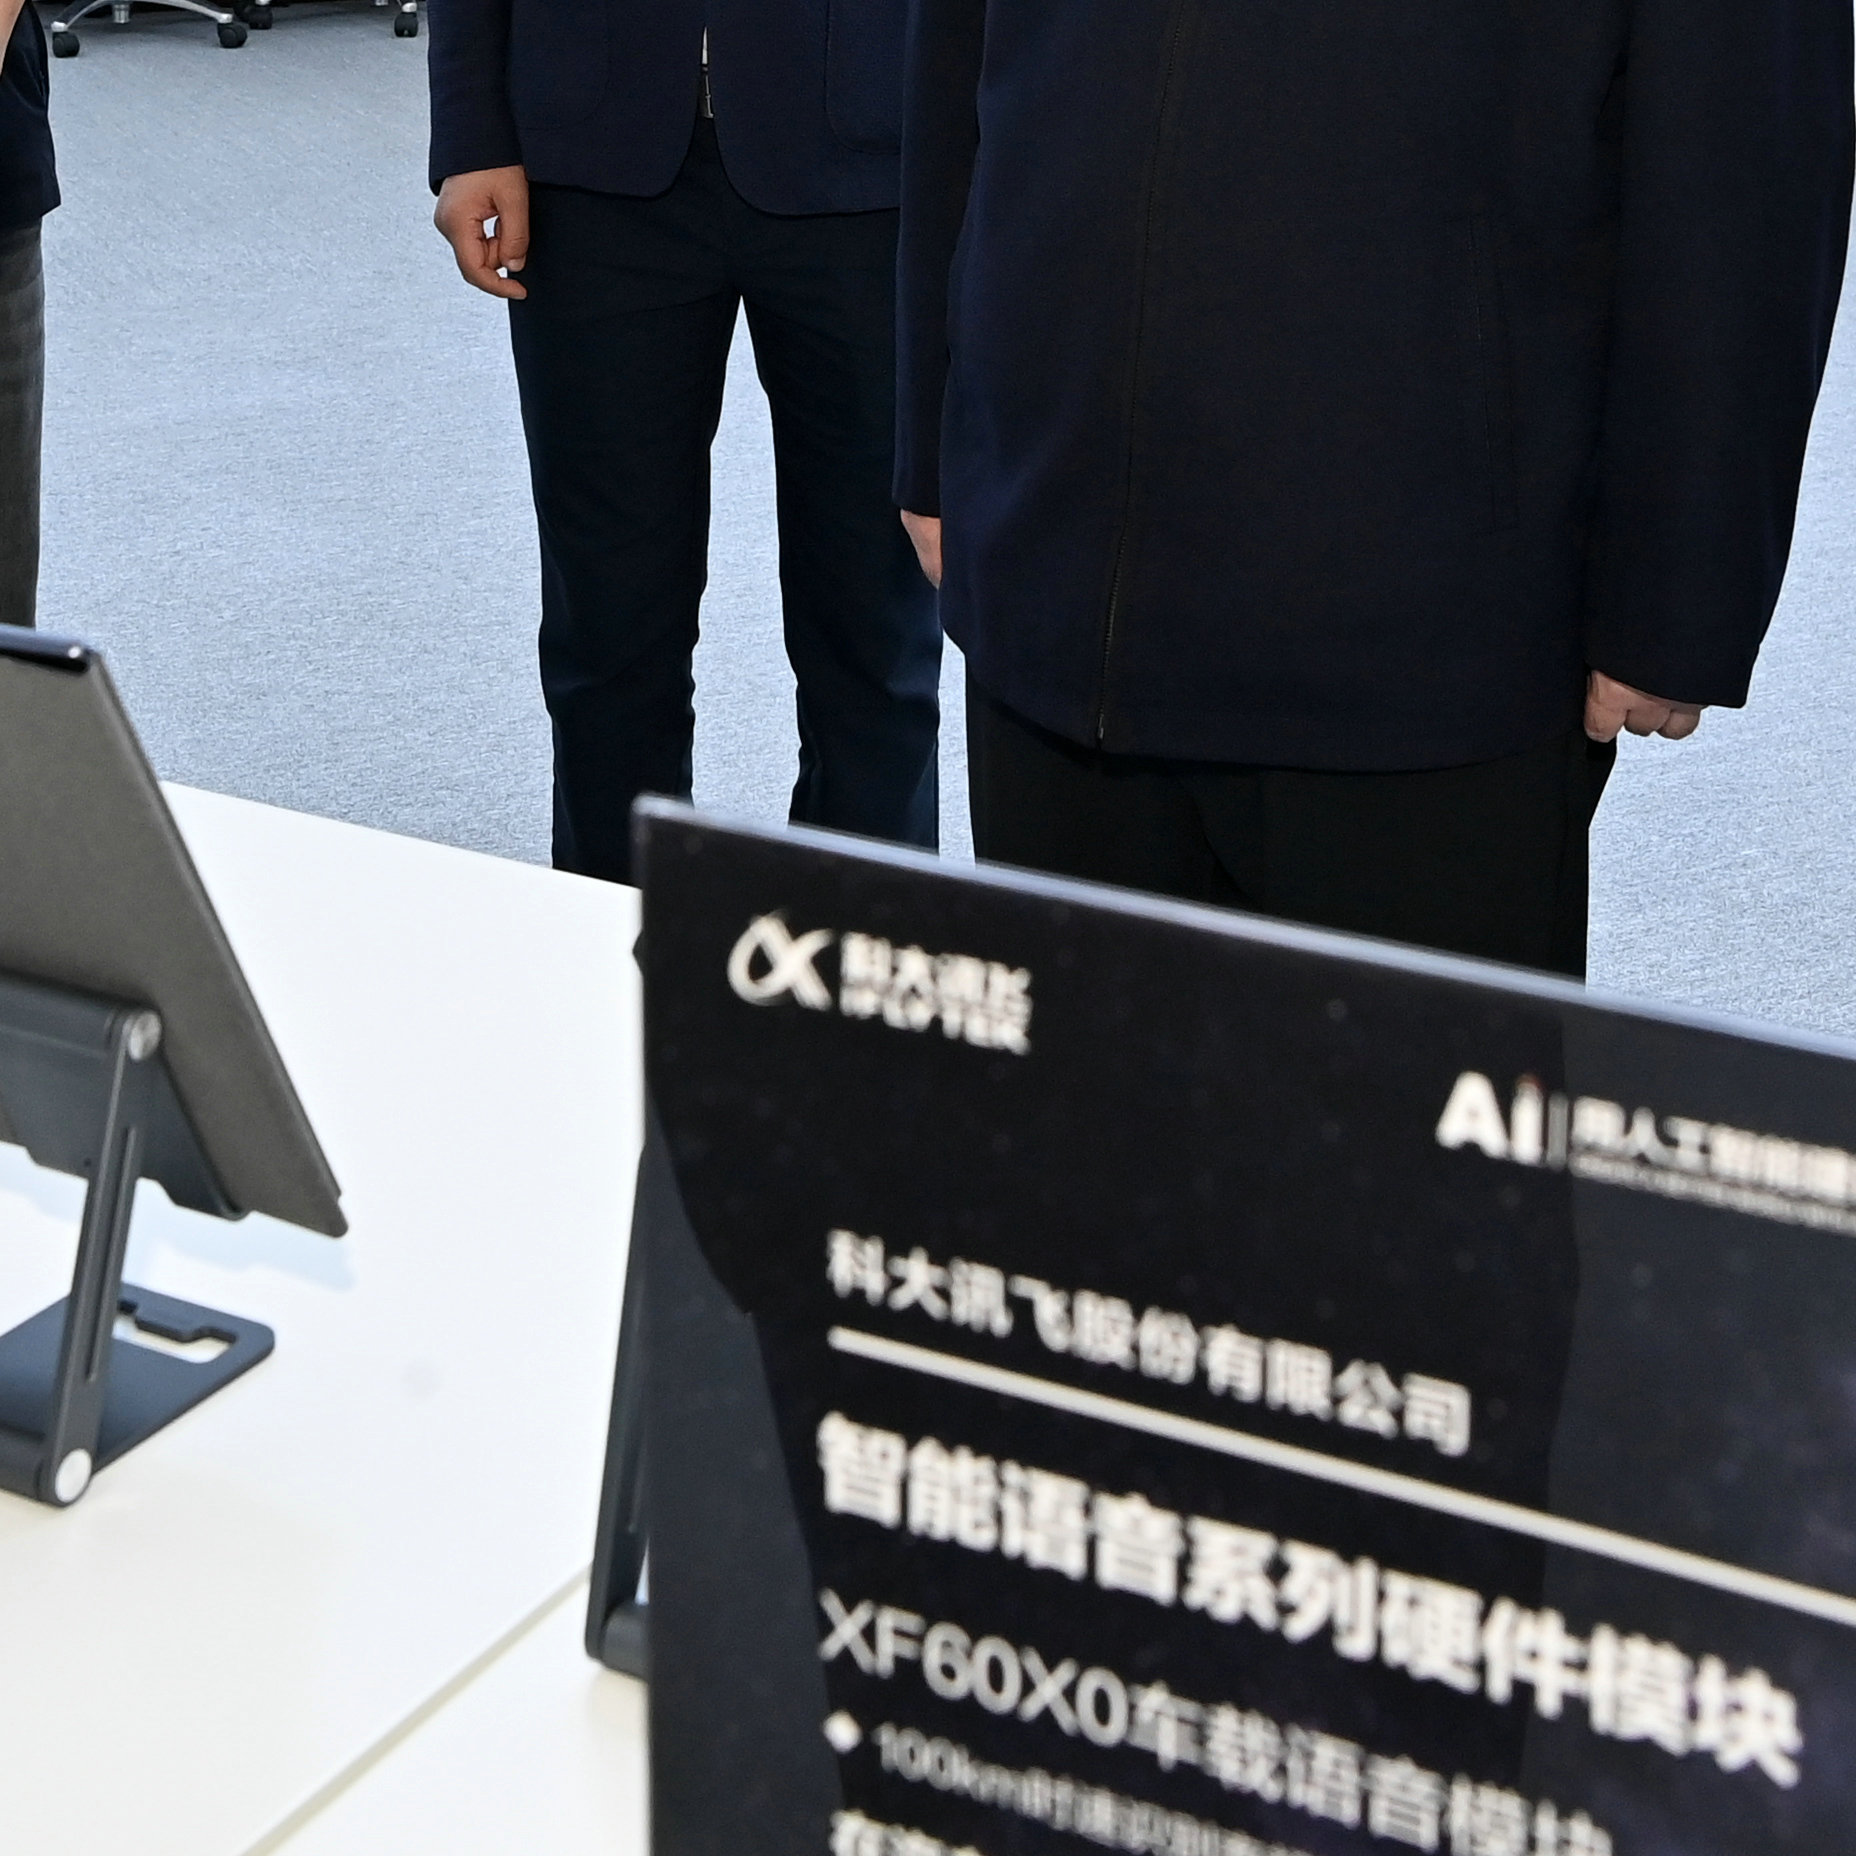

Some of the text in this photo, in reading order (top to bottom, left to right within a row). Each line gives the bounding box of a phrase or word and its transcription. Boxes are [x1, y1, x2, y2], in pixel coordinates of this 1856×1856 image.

[828, 1230, 1472, 1457] 科大讯飞股份有限公司
[817, 1411, 1805, 1787] 智能语音系列硬件模块
